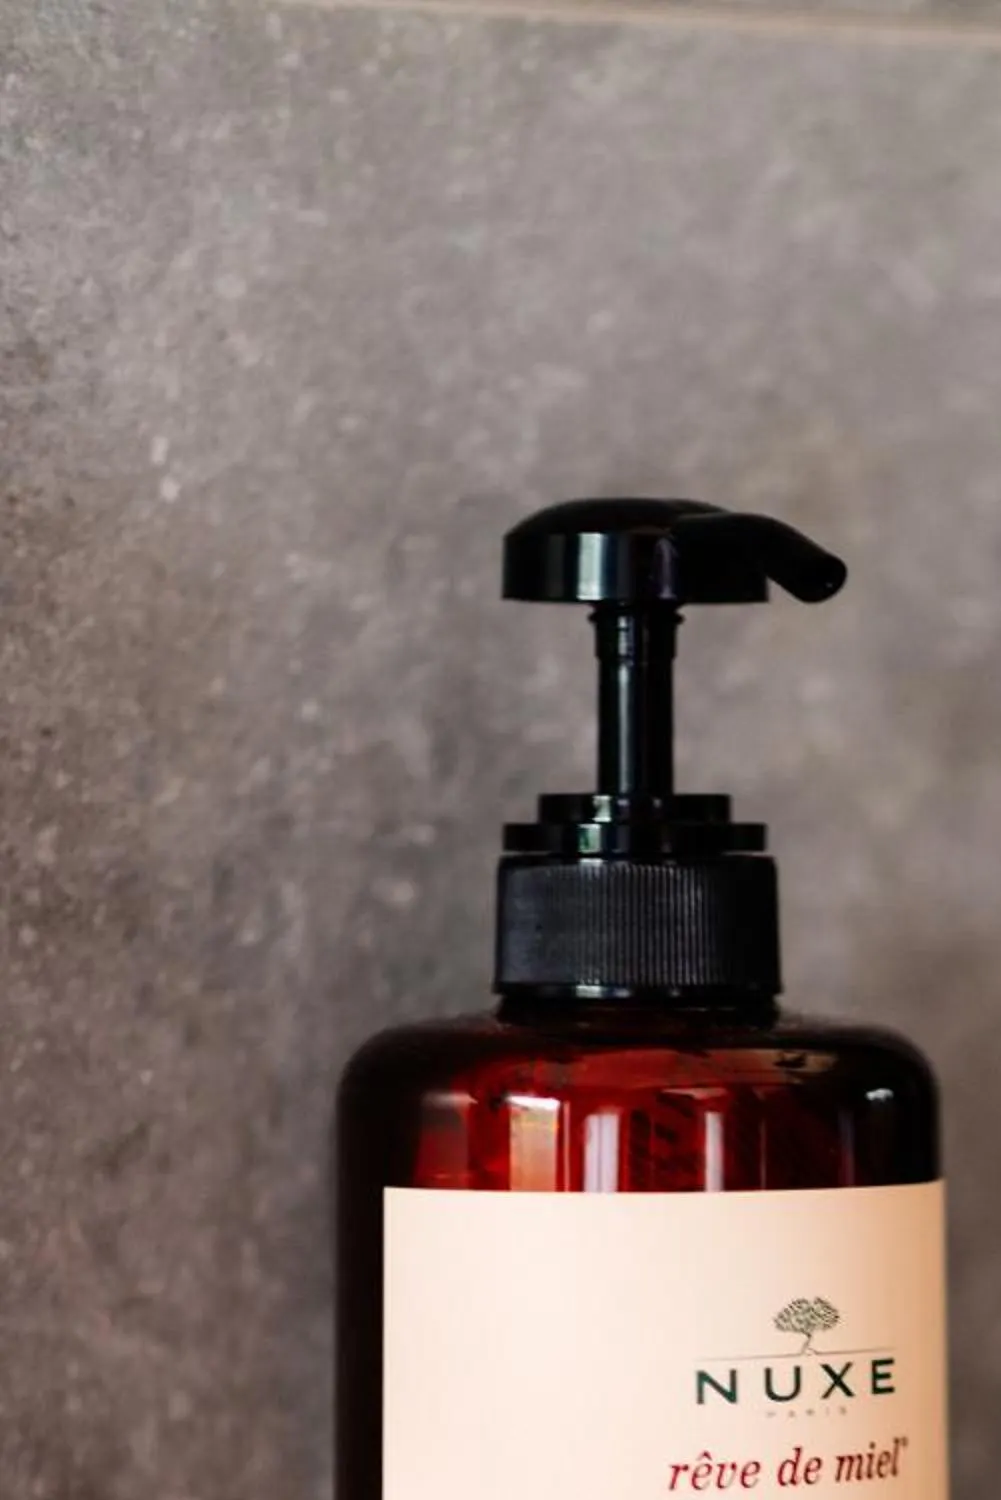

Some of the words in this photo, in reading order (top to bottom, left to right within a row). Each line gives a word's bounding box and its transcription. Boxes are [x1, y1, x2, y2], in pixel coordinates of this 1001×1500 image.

[696, 1358, 896, 1405] NUXE
[668, 1450, 761, 1491] rêve
[777, 1447, 823, 1487] de
